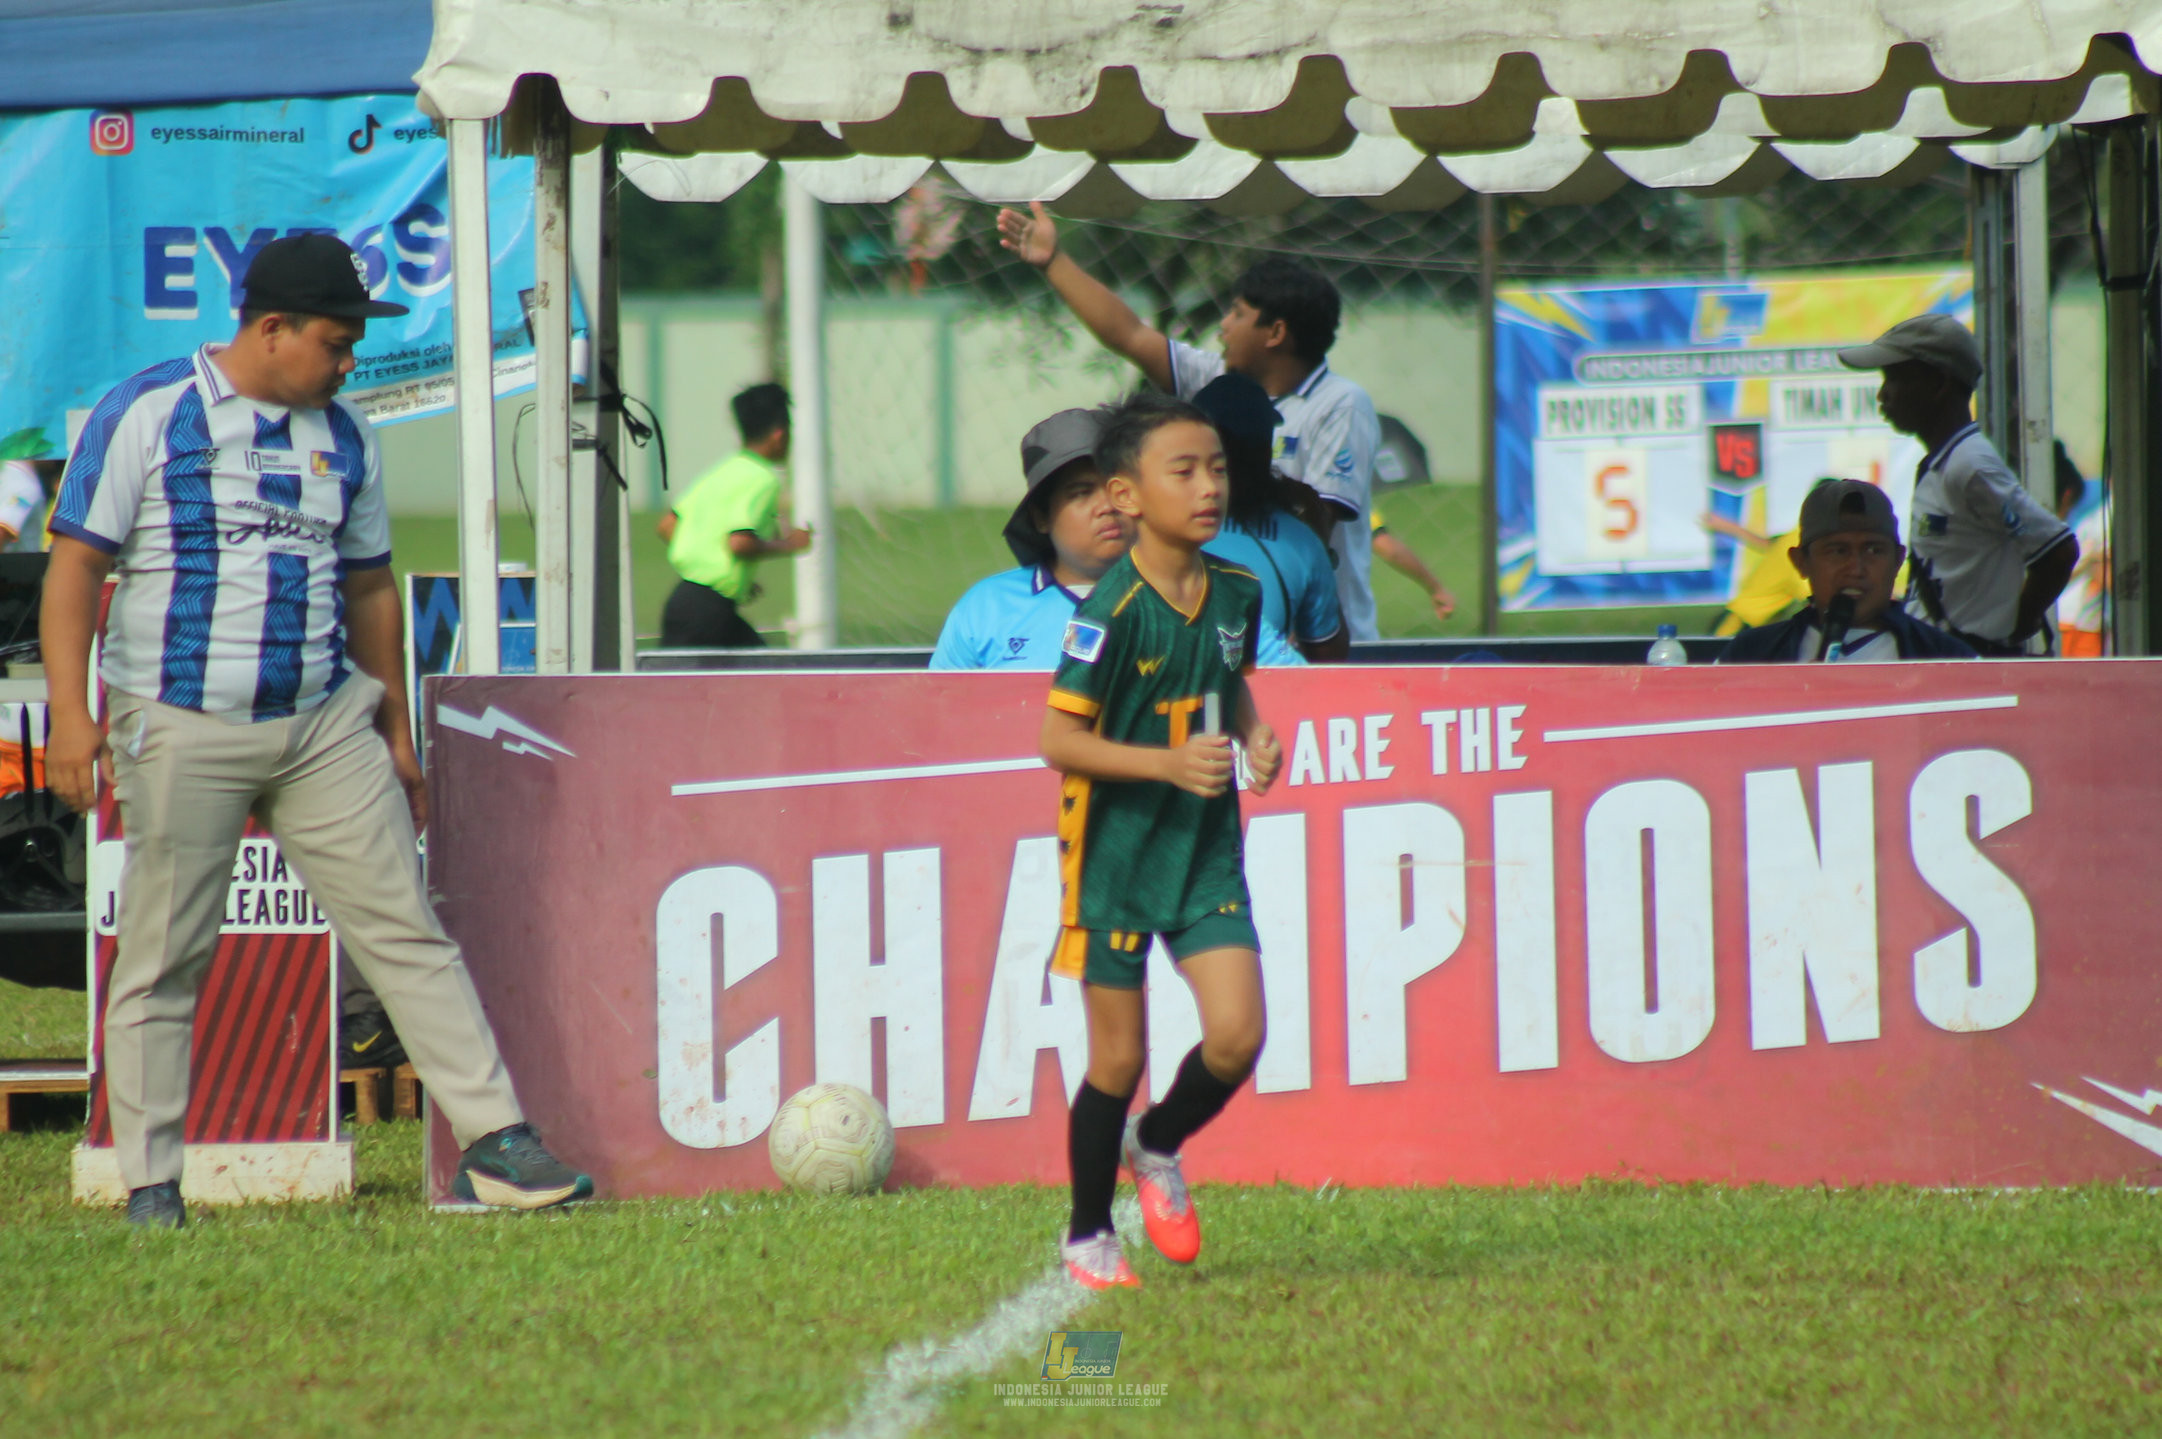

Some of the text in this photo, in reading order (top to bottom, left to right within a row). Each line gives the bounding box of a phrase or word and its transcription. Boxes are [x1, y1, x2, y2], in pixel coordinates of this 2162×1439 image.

[151, 126, 304, 143] eyessairmineral
[354, 371, 371, 382] PT
[375, 362, 419, 379] EYESS
[1585, 354, 1704, 380] INDONESIA
[1704, 351, 1787, 377] JUNIOR
[1547, 396, 1655, 433] PROVISION
[1714, 431, 1758, 478] VS
[1288, 713, 1395, 786] ARE
[1421, 704, 1528, 775] THE
